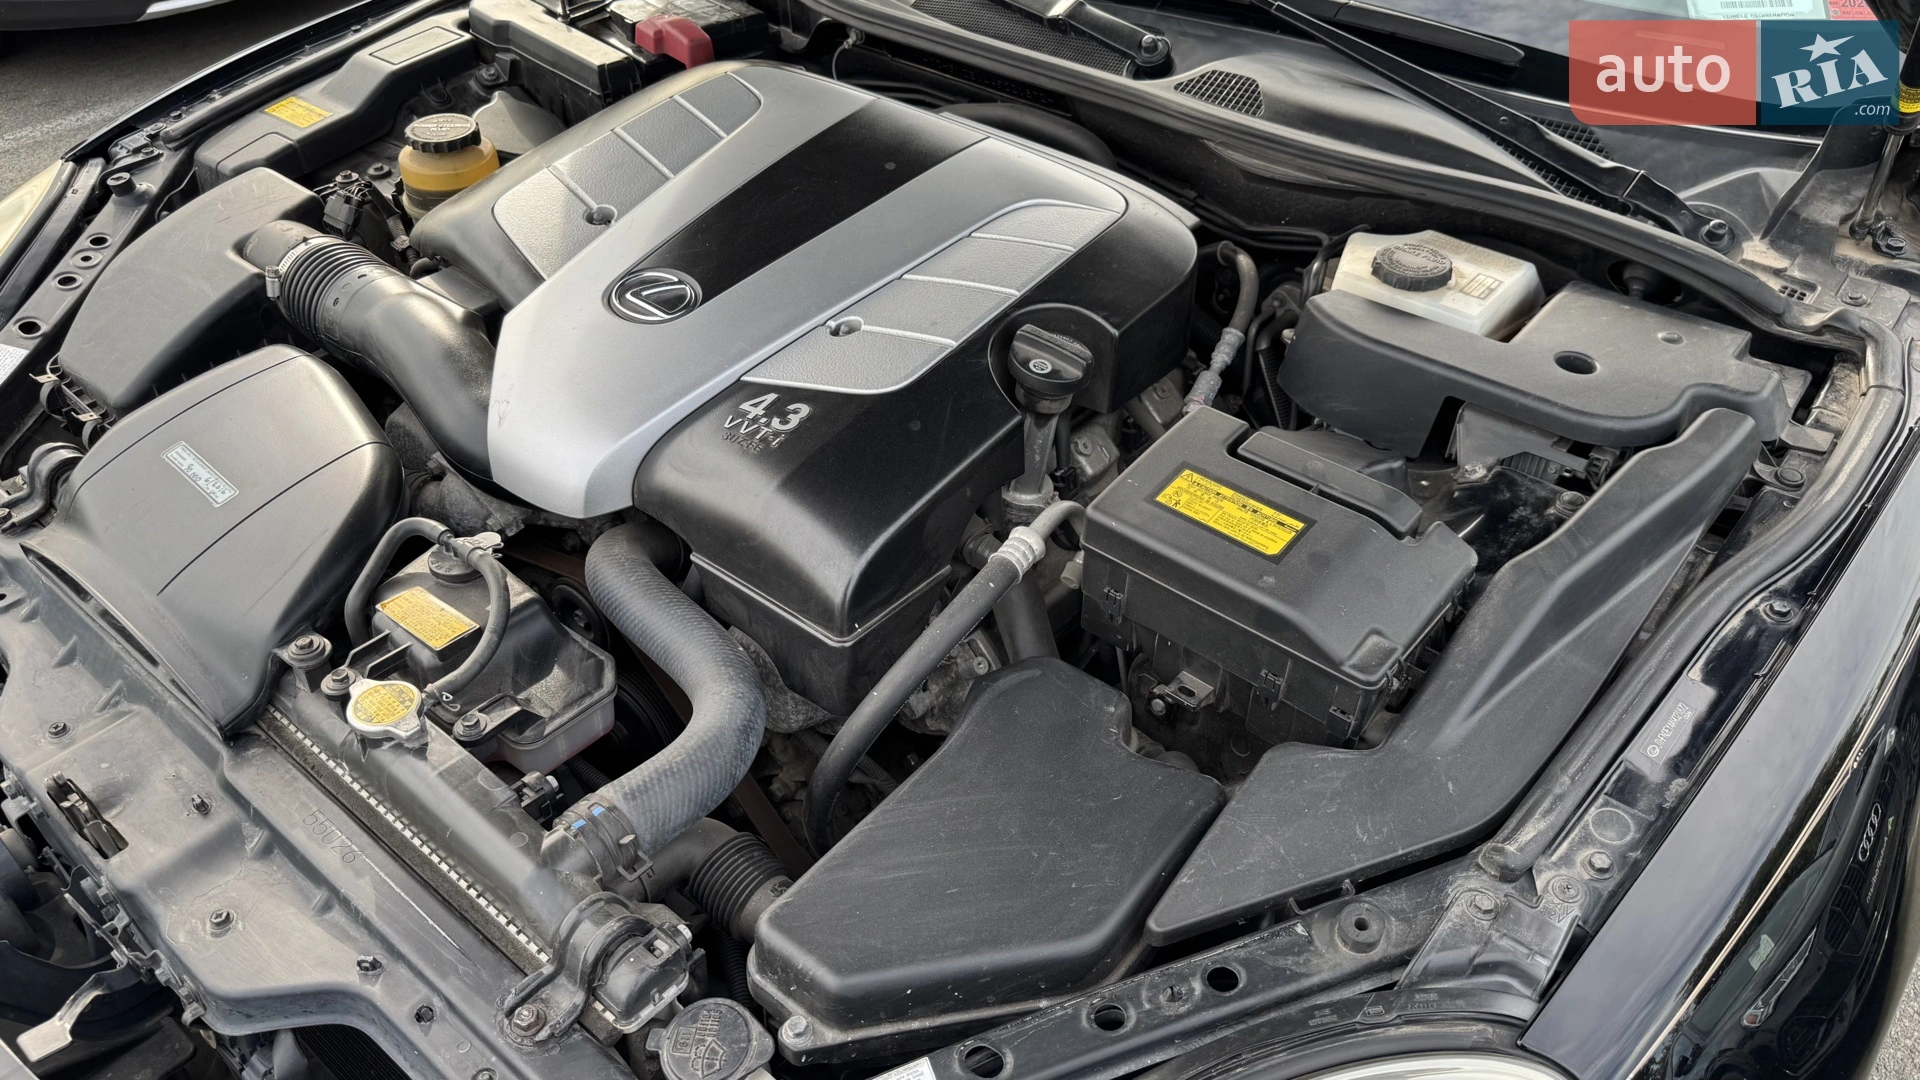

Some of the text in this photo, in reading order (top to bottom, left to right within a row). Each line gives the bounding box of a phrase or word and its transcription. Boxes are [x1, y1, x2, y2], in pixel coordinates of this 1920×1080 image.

[1421, 254, 1447, 266] FLUID
[738, 392, 811, 432] 4.3
[724, 414, 785, 447] VVT-i
[303, 809, 364, 863] 55026
